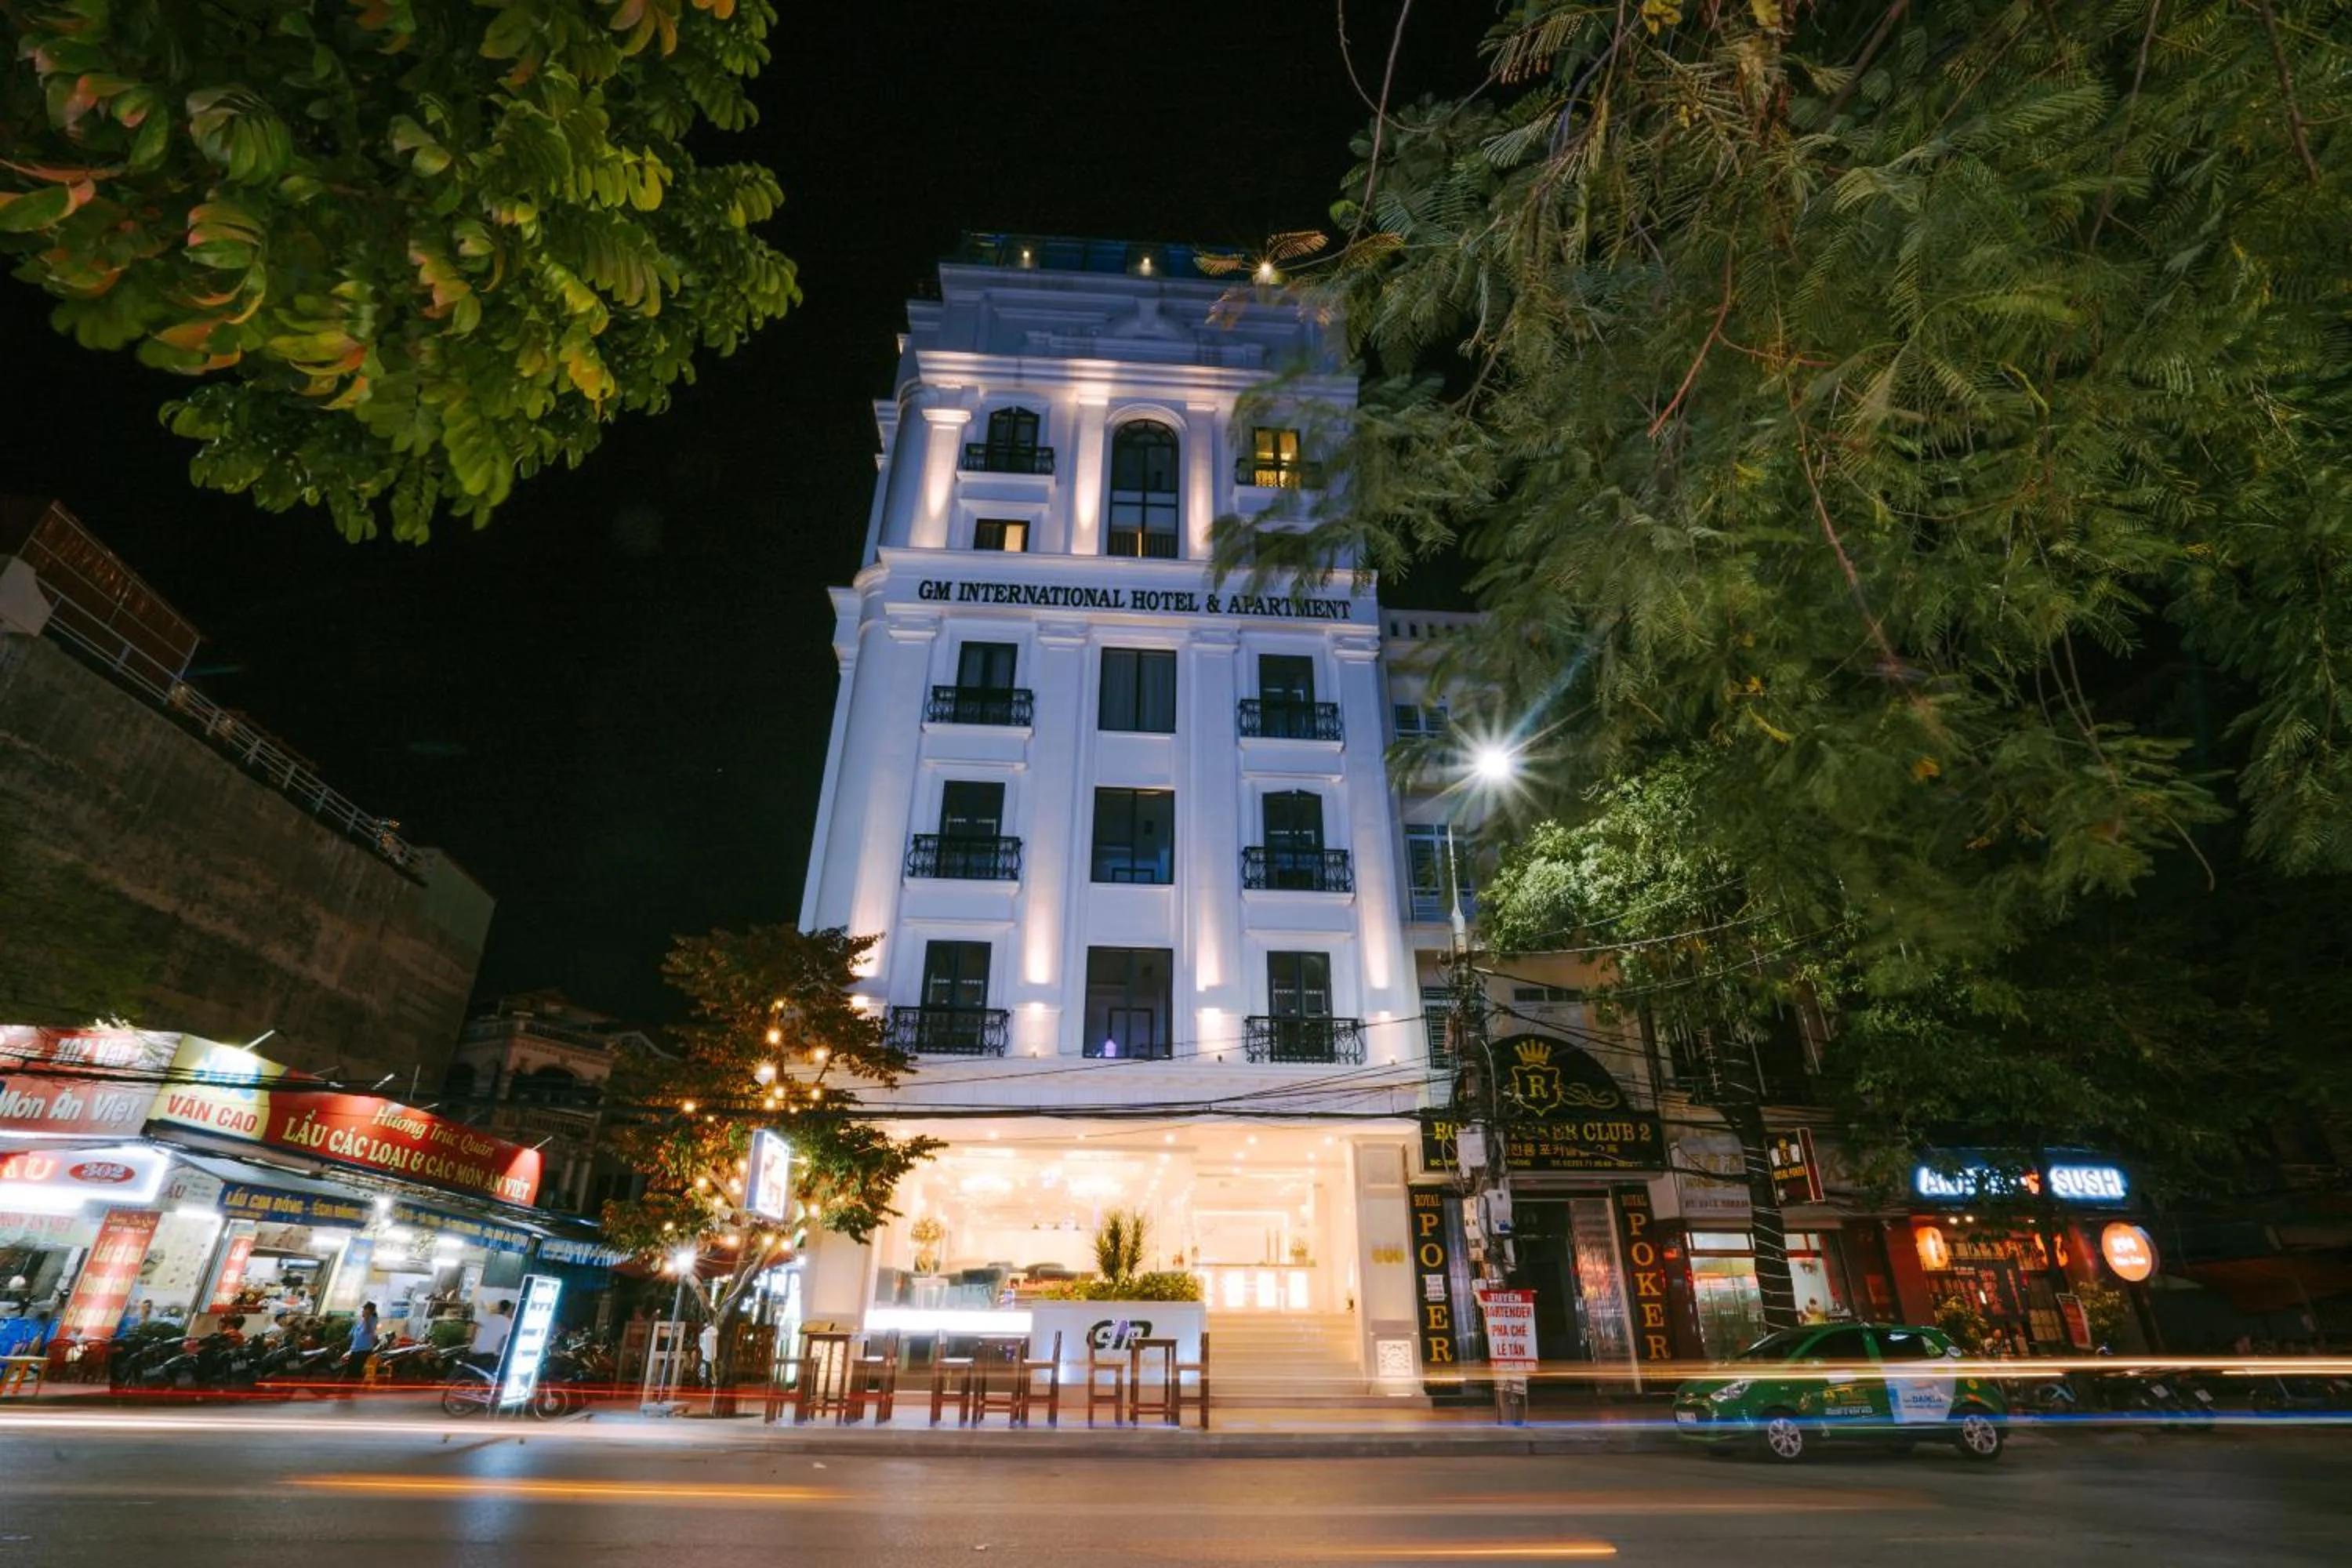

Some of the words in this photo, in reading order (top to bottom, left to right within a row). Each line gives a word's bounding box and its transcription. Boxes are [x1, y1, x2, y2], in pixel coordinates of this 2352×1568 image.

[918, 579, 953, 601] GM
[956, 582, 1126, 609] INTERNATIONAL
[1131, 590, 1200, 612] HOTEL
[1206, 593, 1221, 613] &
[1227, 594, 1352, 619] APARTMENT
[1526, 1074, 1549, 1099] R
[48, 1087, 84, 1120] Ăn
[89, 1093, 141, 1128] Việt
[165, 1092, 214, 1123] VĂN
[216, 1105, 258, 1133] CAO
[372, 1105, 430, 1140] Hương
[1583, 1122, 1635, 1142] CLUB
[1639, 1122, 1652, 1142] 2
[328, 1126, 369, 1159] CÁC
[368, 1141, 411, 1174] LOẠI
[410, 1150, 425, 1172] &
[425, 1152, 458, 1181] CÁC
[1414, 1194, 1442, 1207] ROYAL
[1627, 1213, 1671, 1359] POKER
